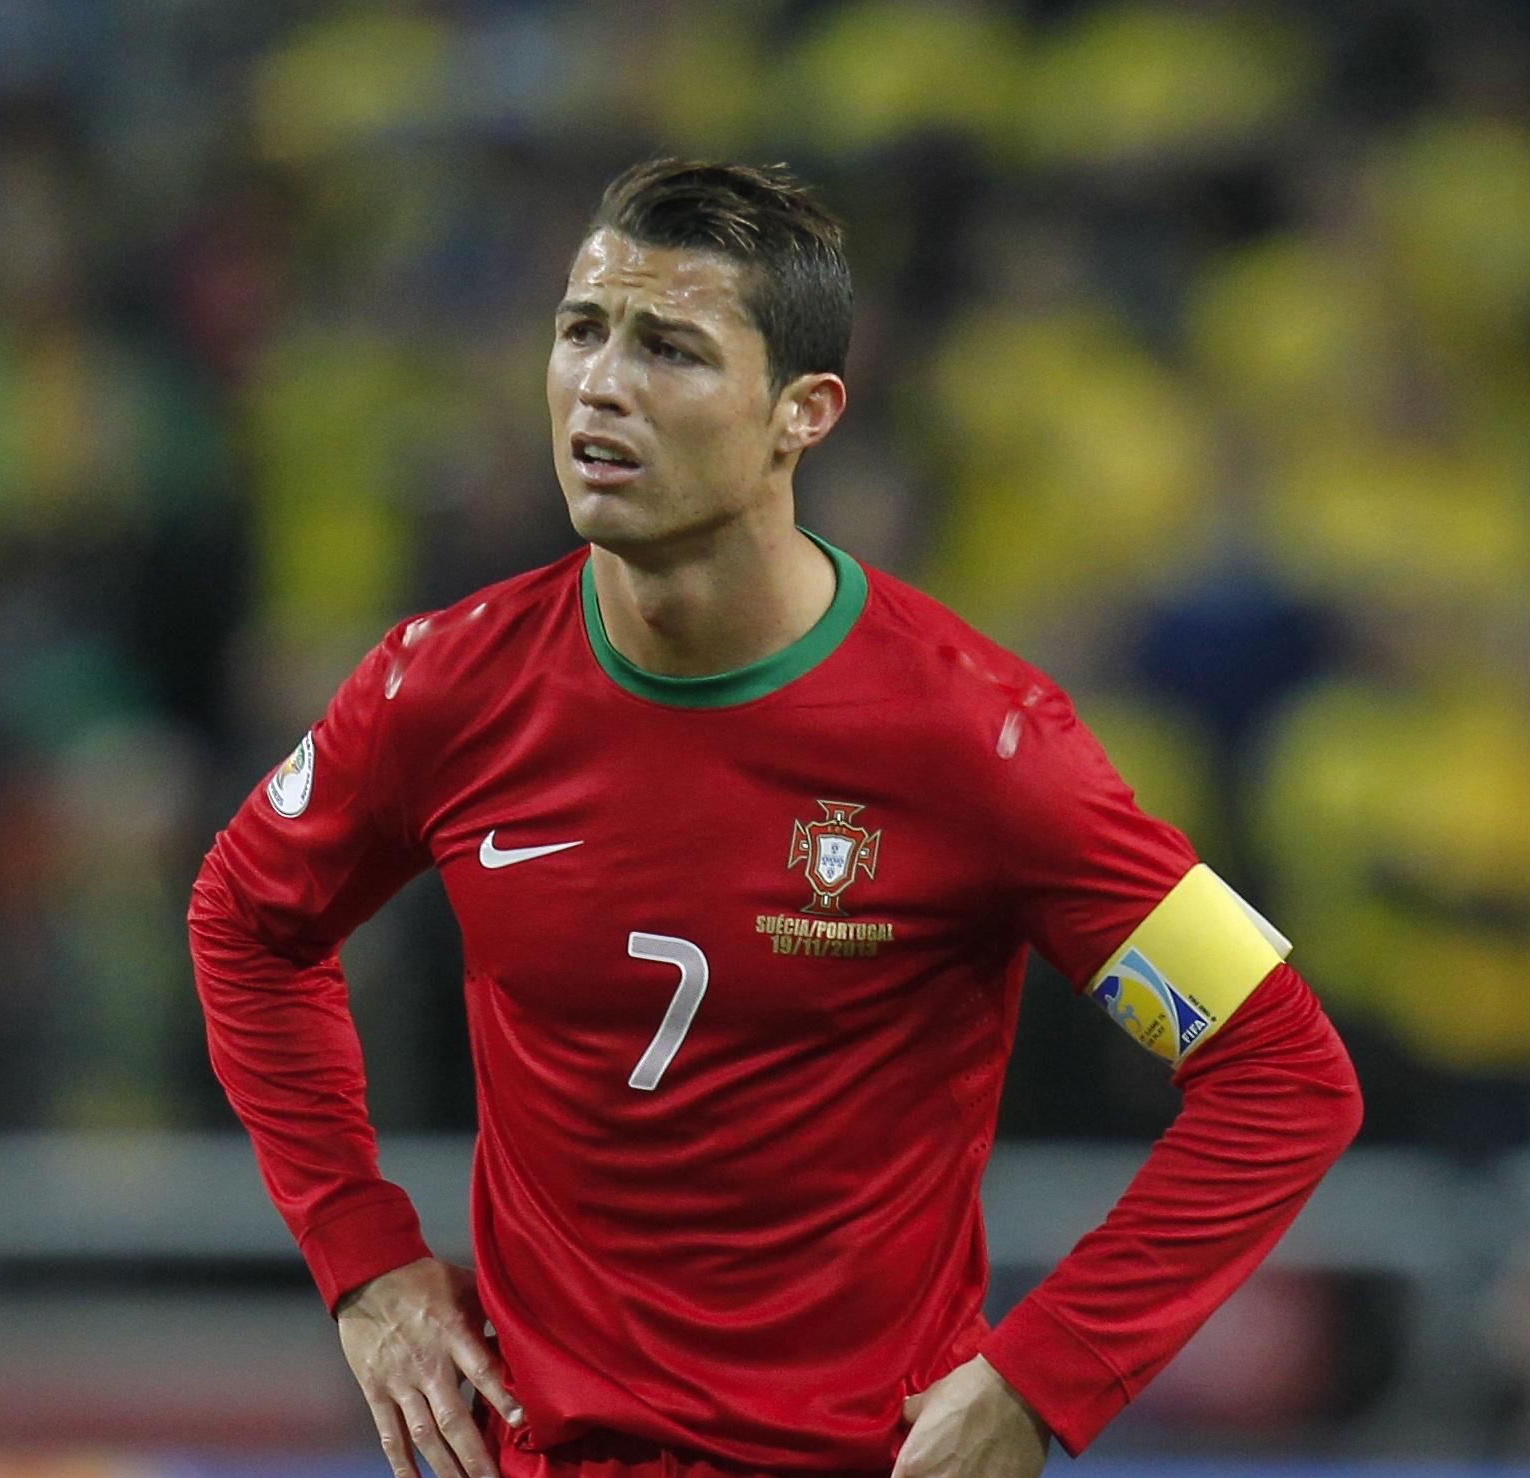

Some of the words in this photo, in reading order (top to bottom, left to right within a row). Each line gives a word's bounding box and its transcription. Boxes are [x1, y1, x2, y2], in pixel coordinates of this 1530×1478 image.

[755, 914, 894, 941] SUÉCIA/PORTUGAL
[628, 931, 709, 1090] 7
[1181, 1020, 1206, 1043] FIFA
